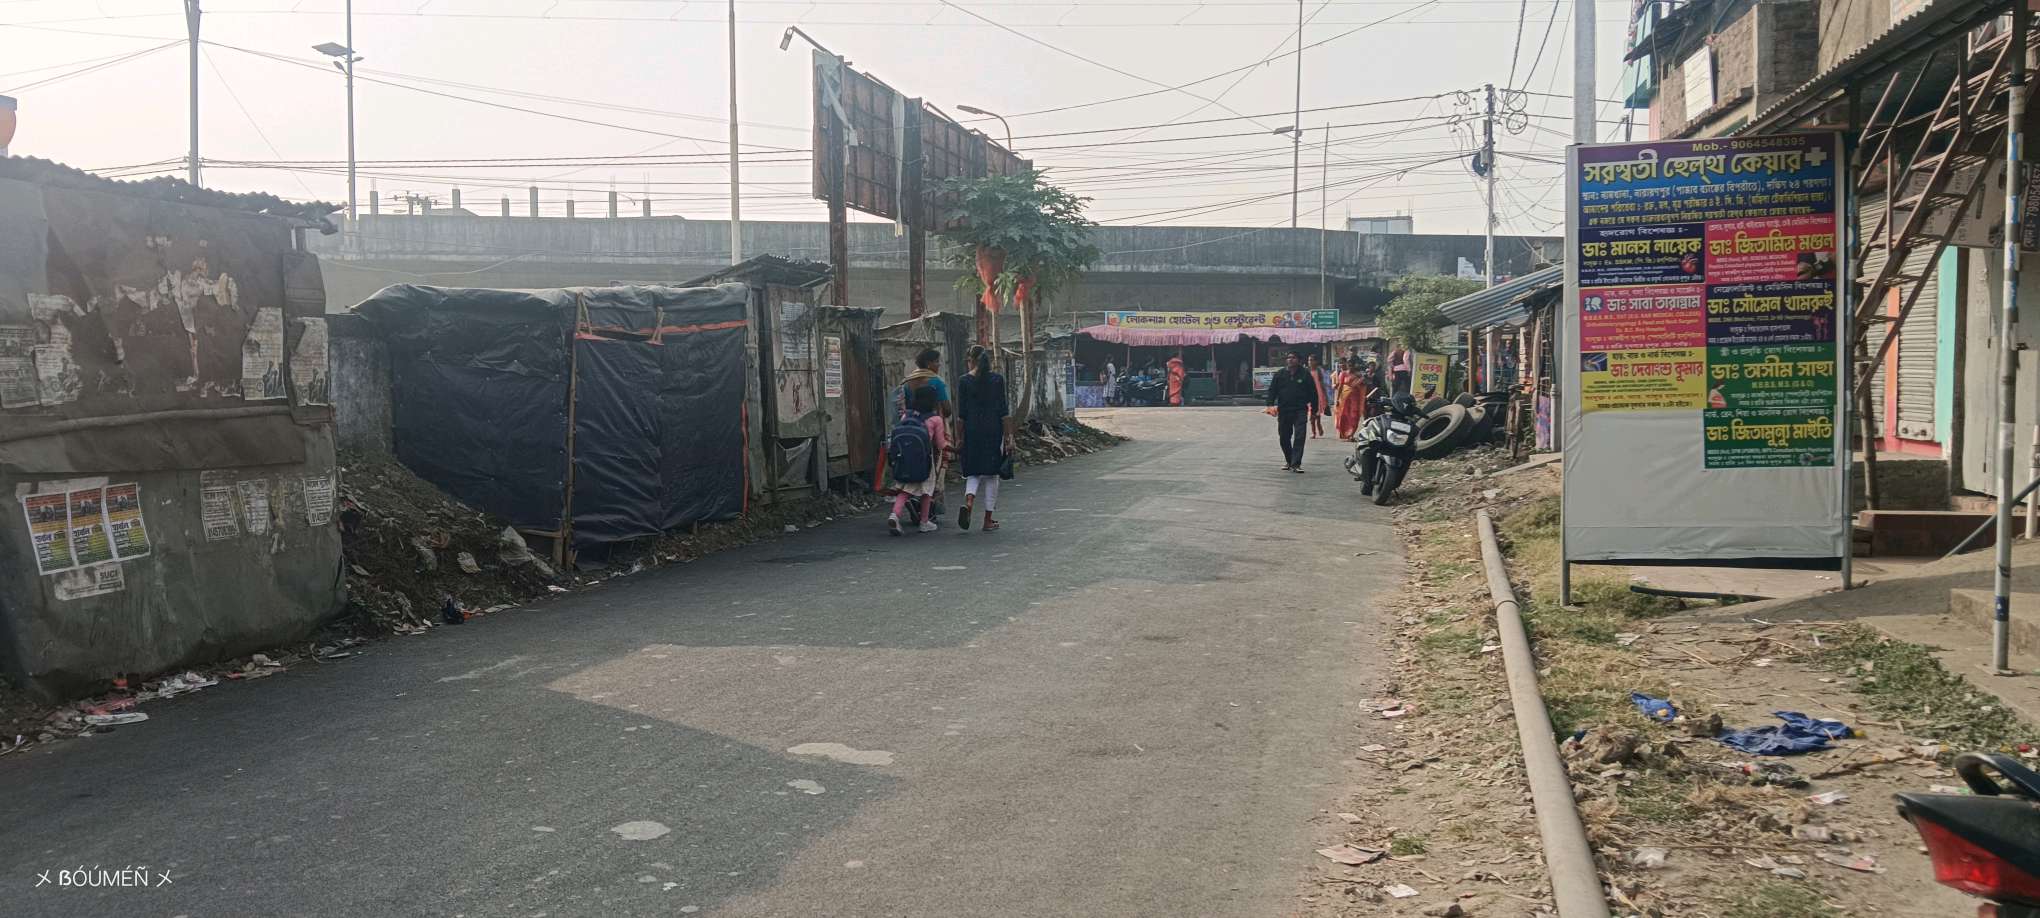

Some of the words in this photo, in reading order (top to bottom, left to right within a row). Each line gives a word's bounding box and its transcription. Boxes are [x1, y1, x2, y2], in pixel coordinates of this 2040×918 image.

[1583, 148, 1659, 185] সরস্বতী
[1730, 150, 1803, 175] কেয়ার
[1582, 242, 1608, 256] ডাঃ
[1609, 240, 1651, 256] মানস
[1709, 239, 1732, 255] ডাঃ
[1735, 229, 1797, 253] জিতামিত্র
[1607, 298, 1627, 312] ডাঃ
[1628, 297, 1653, 310] সাবা
[1707, 298, 1730, 314] ডাঃ
[1732, 292, 1781, 313] সৌমেন
[1783, 289, 1834, 312] খামরুই
[1168, 313, 1200, 325] হোটেল
[1610, 363, 1629, 377] ডাঃ
[1674, 361, 1704, 382] কুমার
[1710, 363, 1739, 379] ডাঃ
[1743, 354, 1794, 378] অসীম
[1796, 361, 1834, 377] সাহা
[1706, 426, 1729, 441] ডাঃ
[1791, 416, 1833, 439] মাইতি
